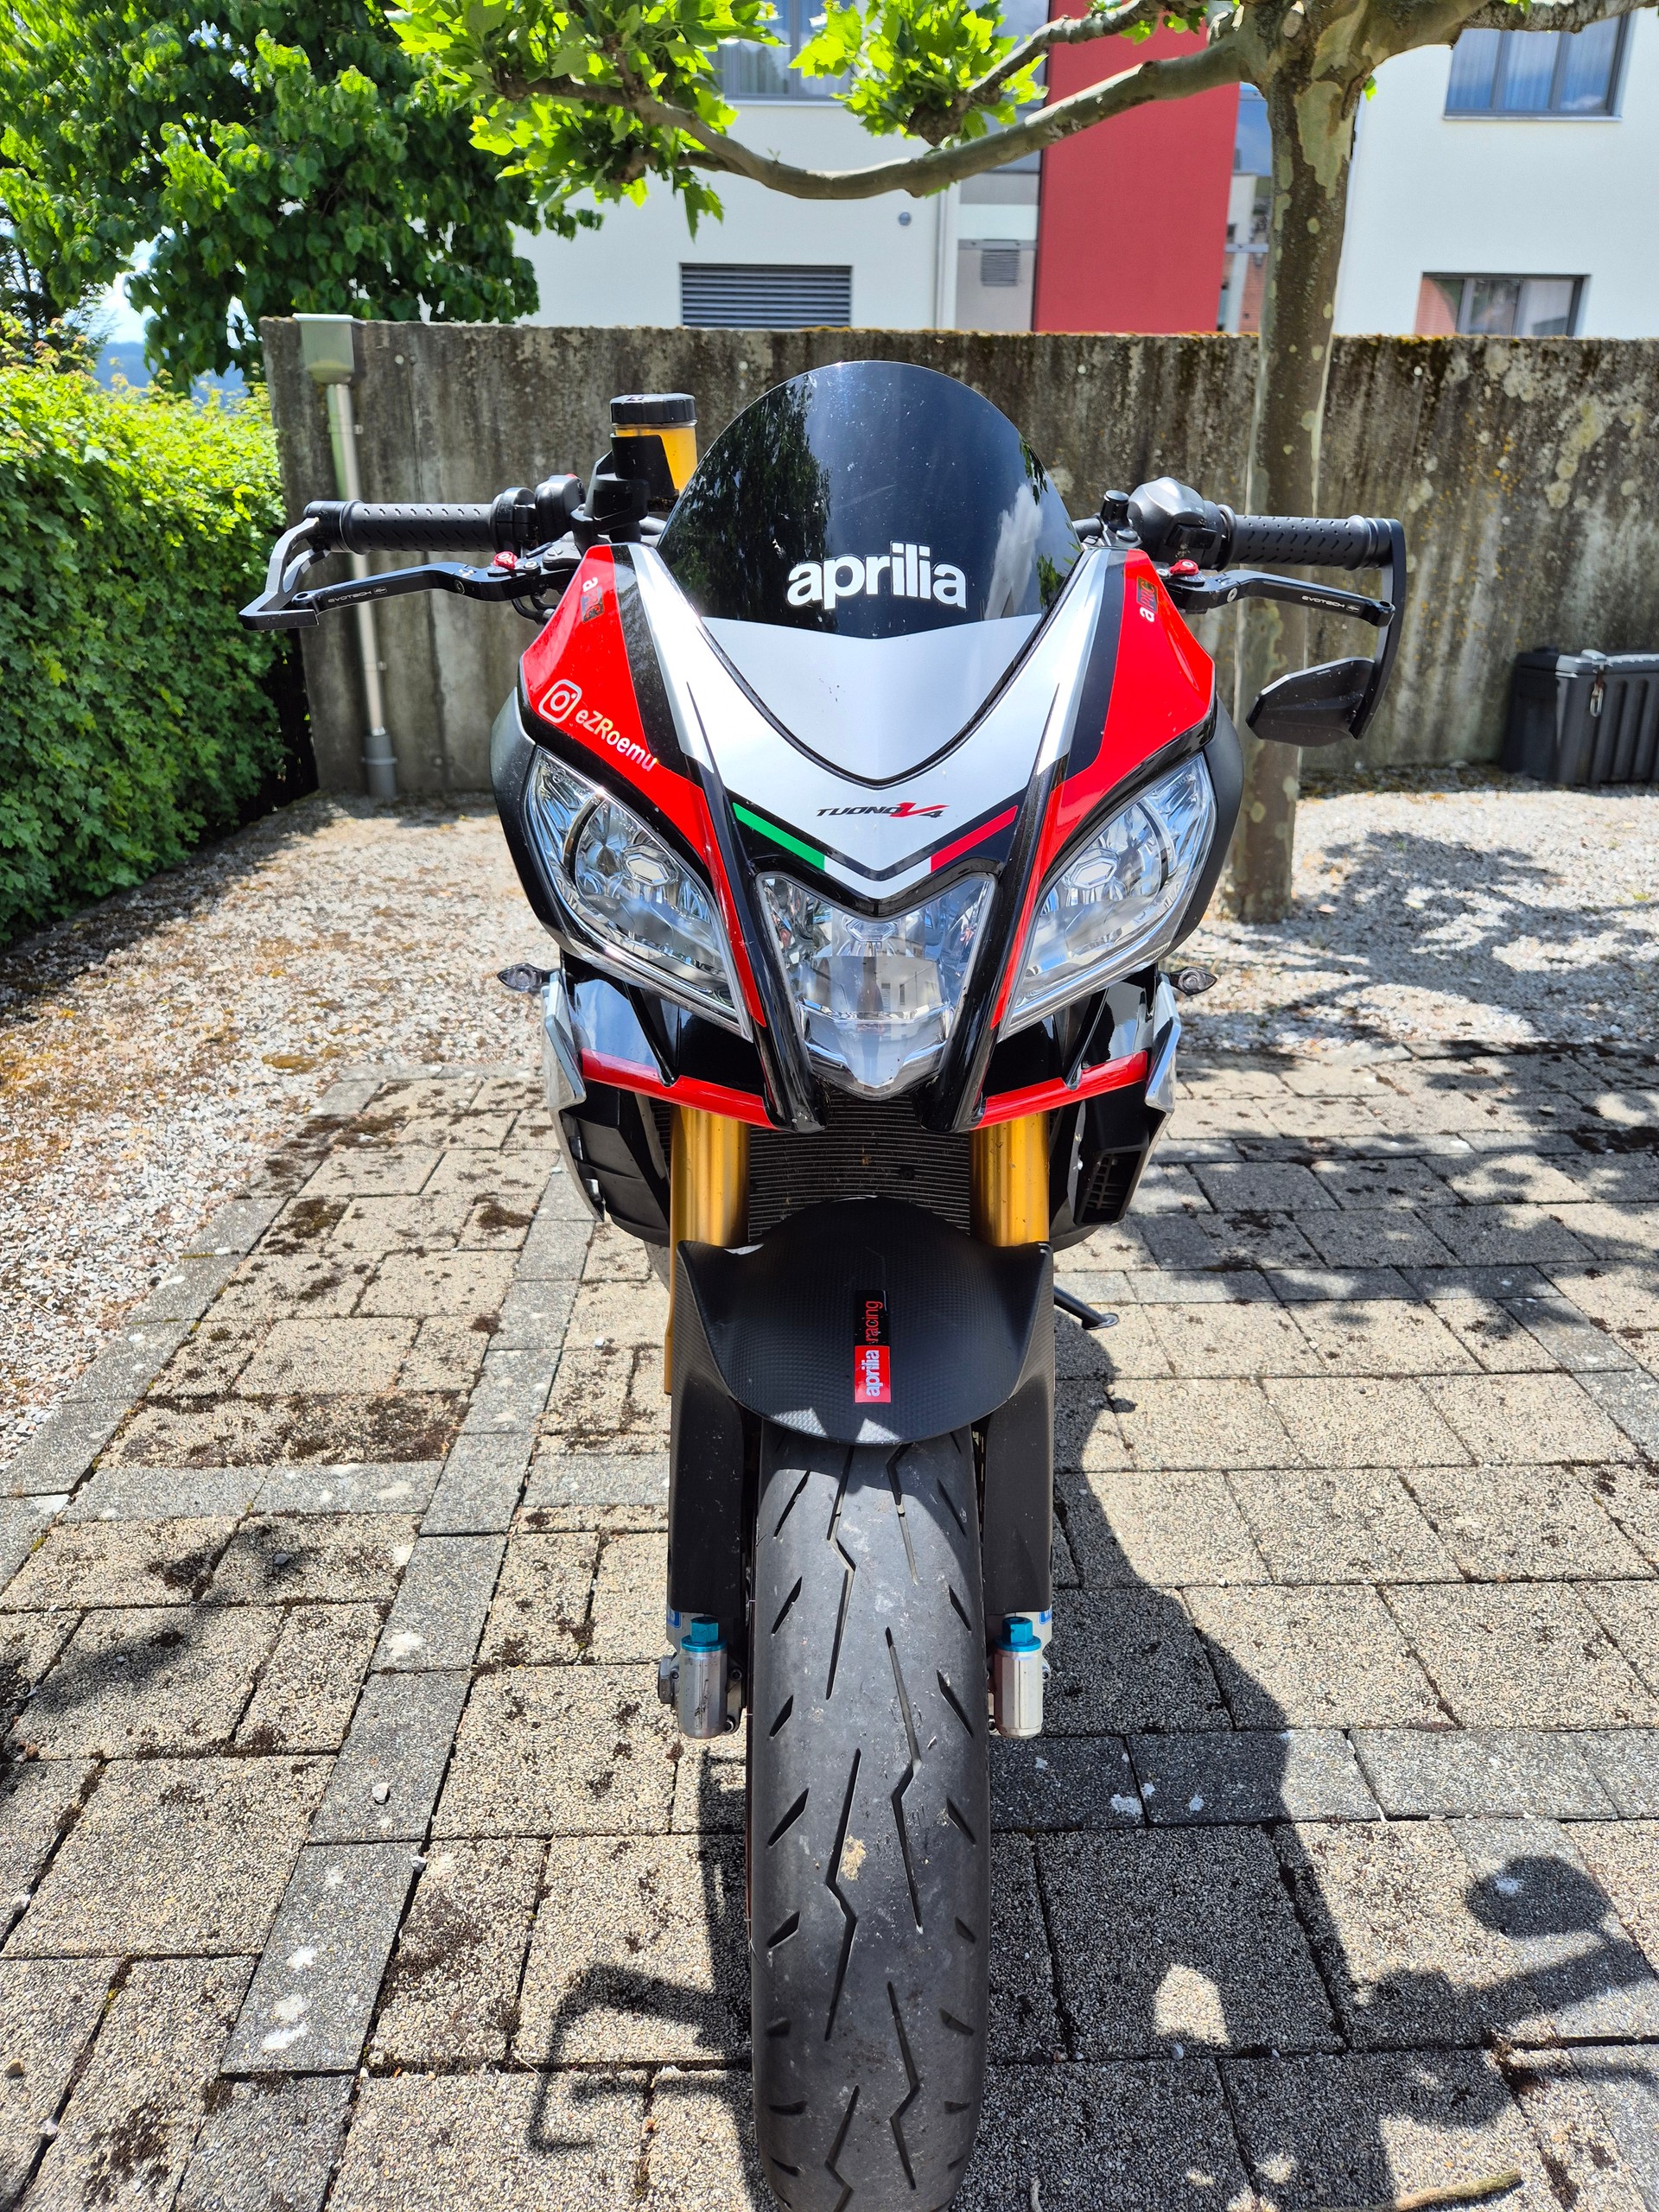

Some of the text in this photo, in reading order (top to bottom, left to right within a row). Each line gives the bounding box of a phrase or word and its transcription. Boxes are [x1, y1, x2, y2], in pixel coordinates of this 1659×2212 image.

[787, 542, 967, 610] aprilia
[575, 709, 658, 772] eZRoemu
[861, 1300, 883, 1397] aprilia racing
